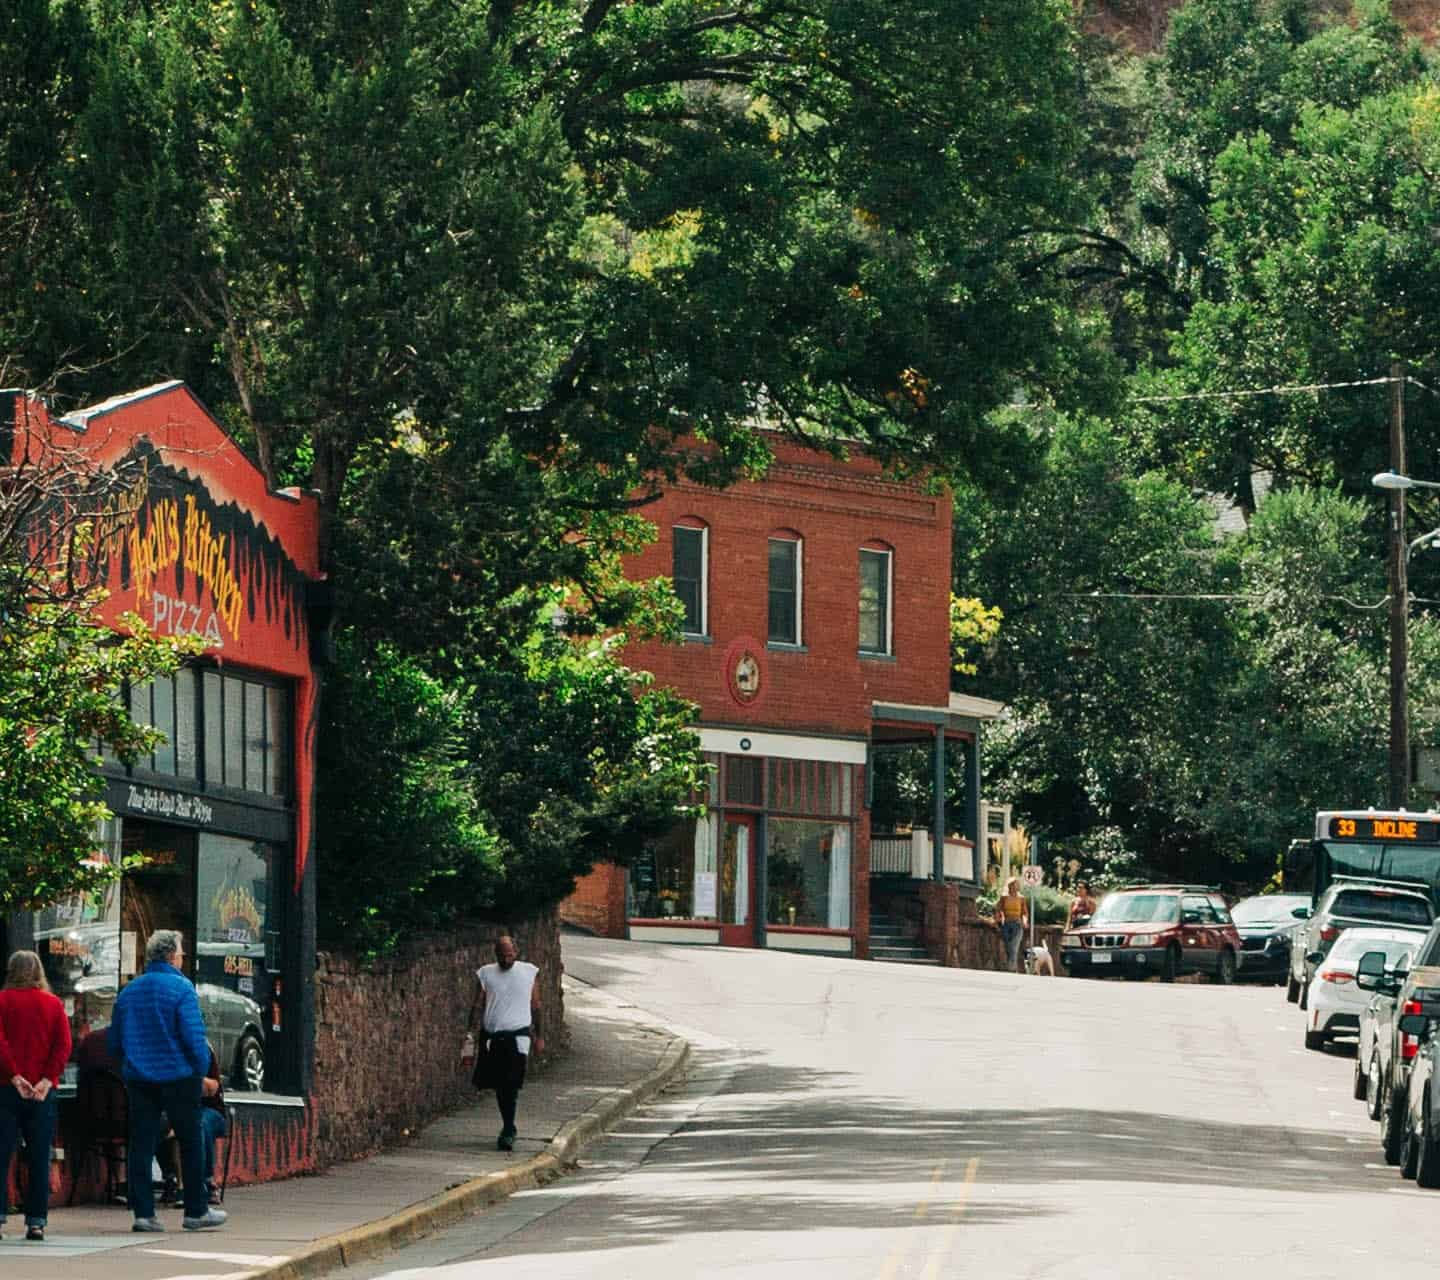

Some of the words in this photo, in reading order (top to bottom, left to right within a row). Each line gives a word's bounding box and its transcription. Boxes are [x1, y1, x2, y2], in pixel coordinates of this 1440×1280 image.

[184, 494, 243, 641] Kitchen
[153, 591, 224, 648] PIZZA
[1338, 820, 1356, 836] 33
[1373, 821, 1417, 838] INCLINE
